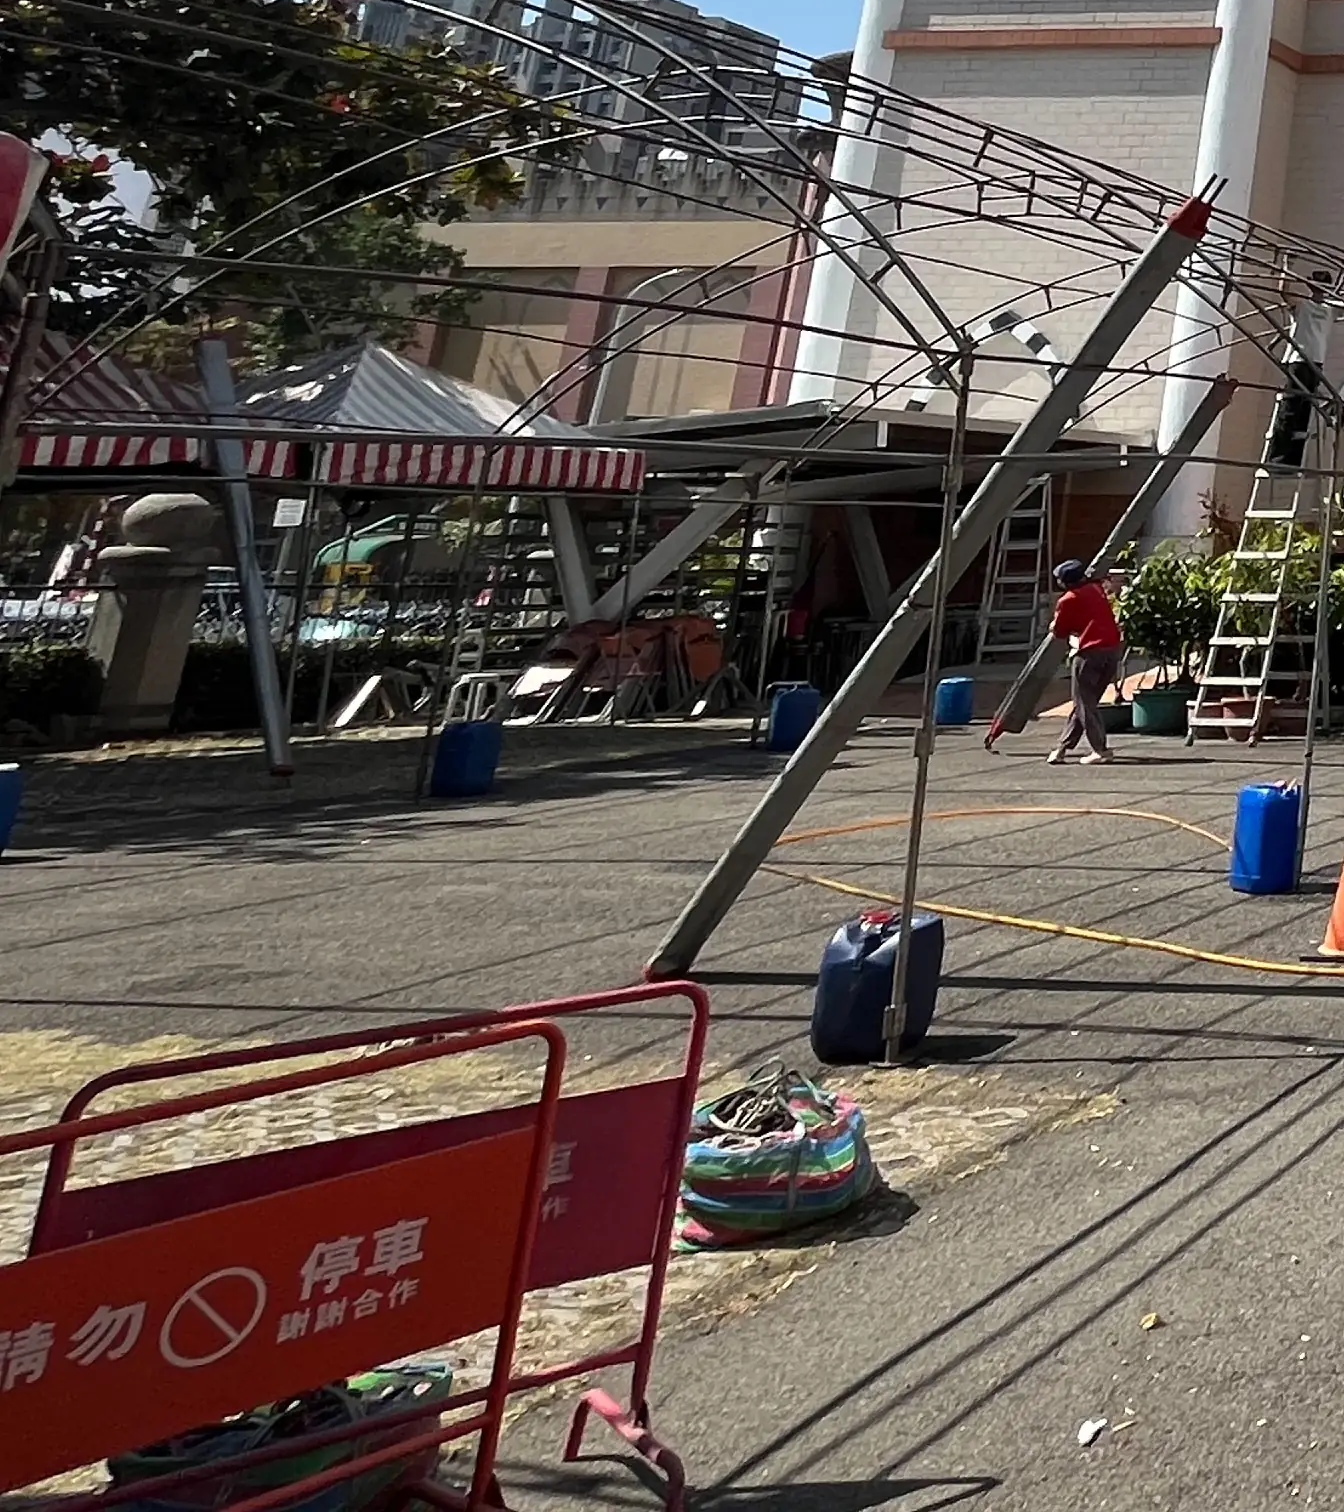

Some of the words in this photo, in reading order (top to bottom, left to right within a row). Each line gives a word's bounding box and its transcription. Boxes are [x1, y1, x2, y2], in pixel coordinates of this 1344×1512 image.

[299, 1216, 430, 1301] 停車
[275, 1277, 421, 1345] 謝謝合作
